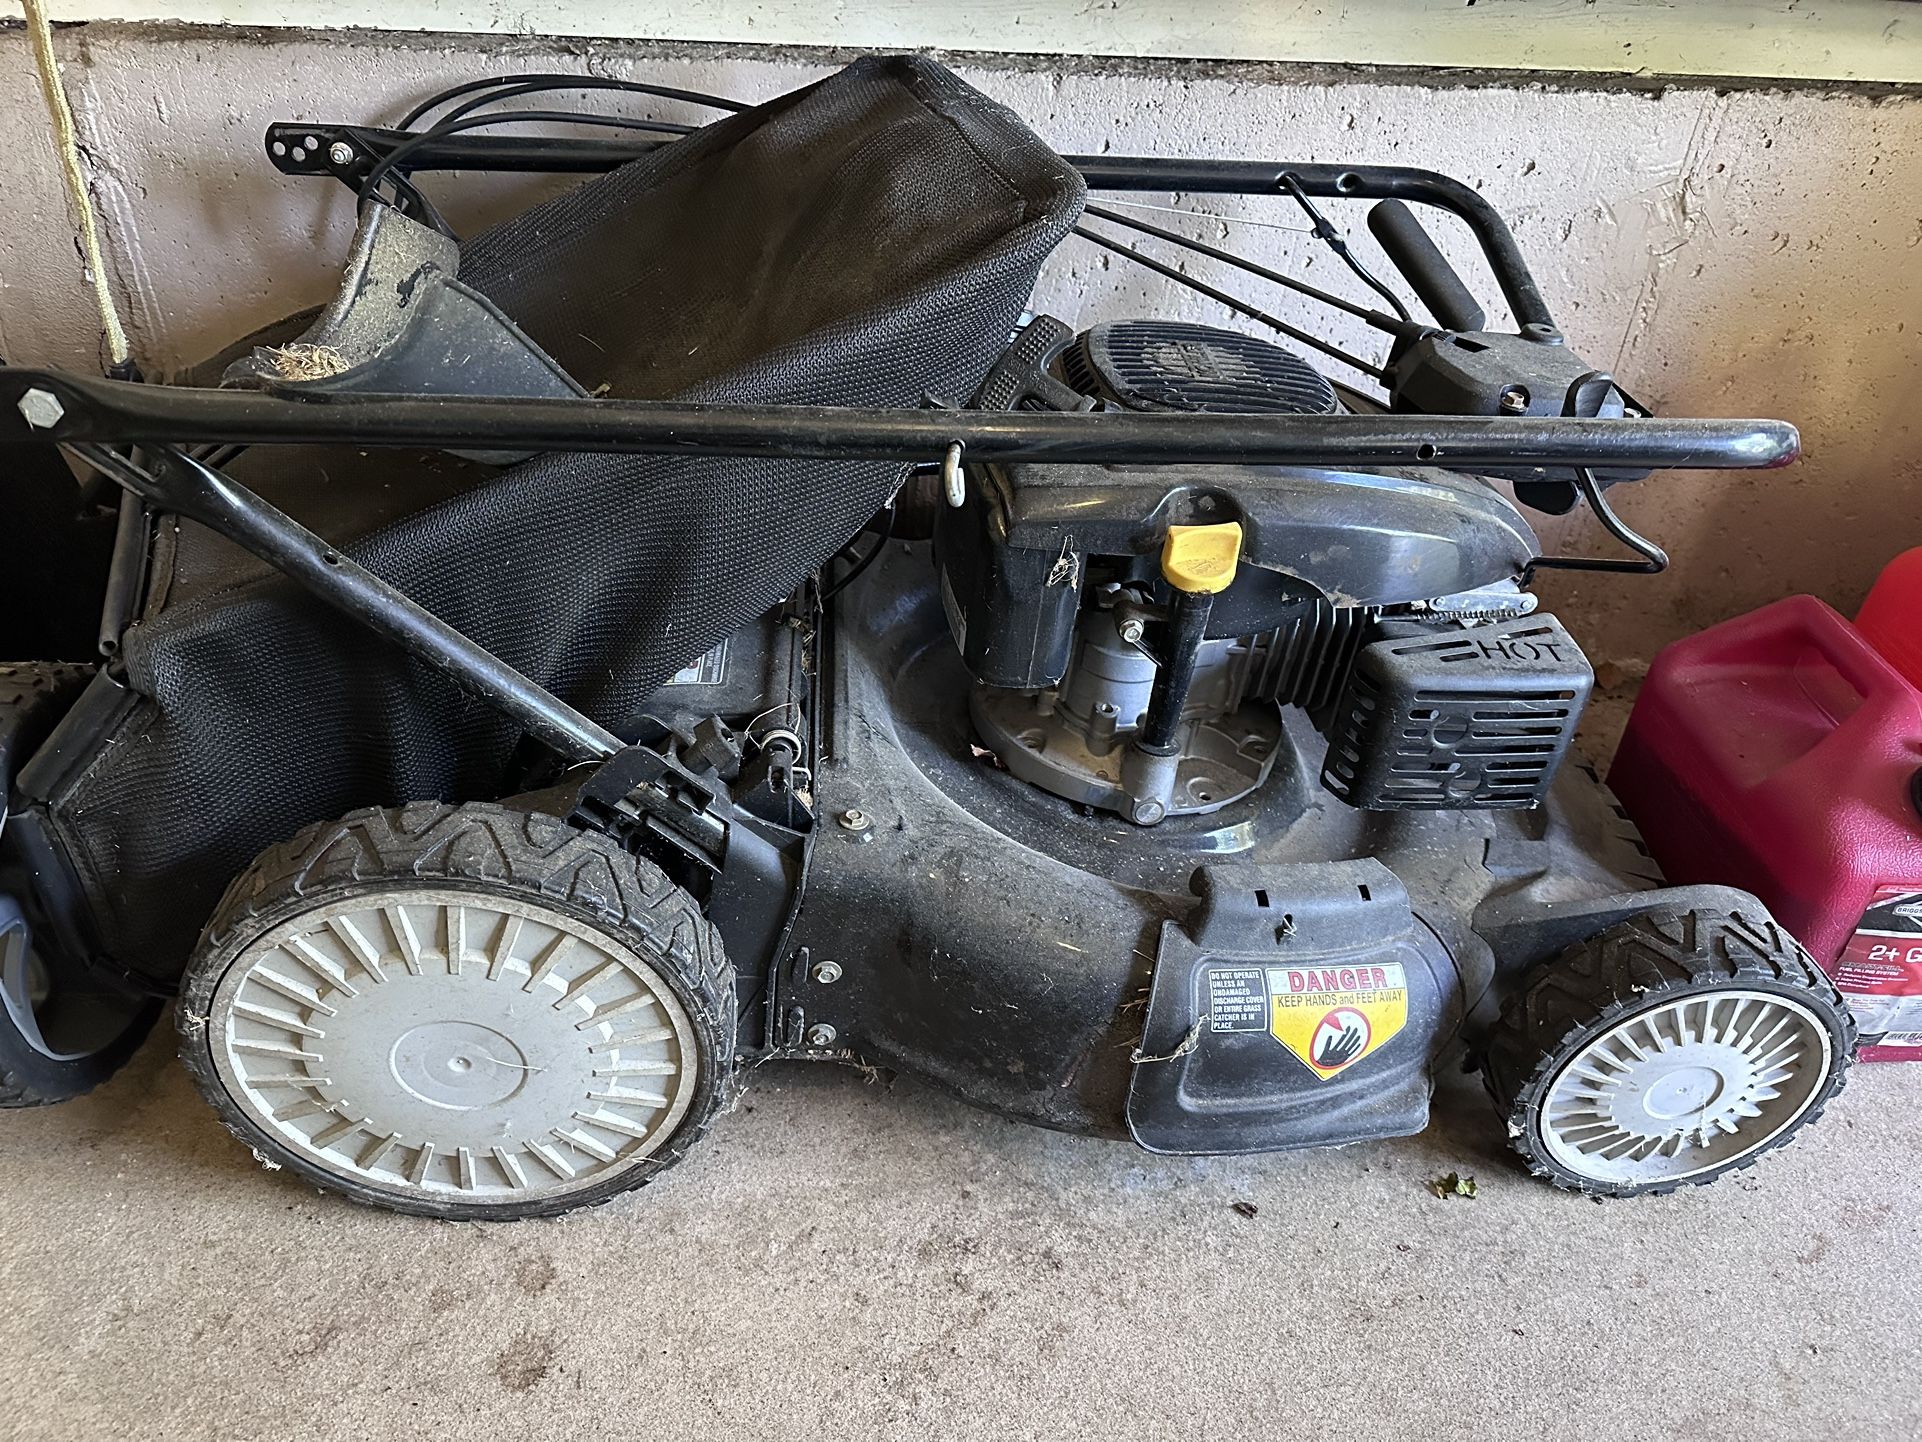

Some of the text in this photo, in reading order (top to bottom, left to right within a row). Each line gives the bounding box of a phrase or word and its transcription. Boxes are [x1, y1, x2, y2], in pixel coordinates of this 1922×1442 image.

[1476, 640, 1561, 662] HOT
[1868, 944, 1900, 961] 2+
[1211, 972, 1220, 980] DO
[1233, 971, 1260, 979] OPERATE
[1287, 967, 1388, 993] DANGER
[1212, 980, 1236, 988] UNLESS
[1213, 988, 1251, 996] UNDAMAGED
[1213, 996, 1264, 1005] DISCHARGE COVER
[1277, 990, 1403, 1008] KEEP HANDS and FEET AWAY
[1214, 1004, 1262, 1013] OR ENTIRE GRASS
[1214, 1013, 1255, 1022] CATCHER IS IN
[1213, 1022, 1235, 1030] PLACE.
